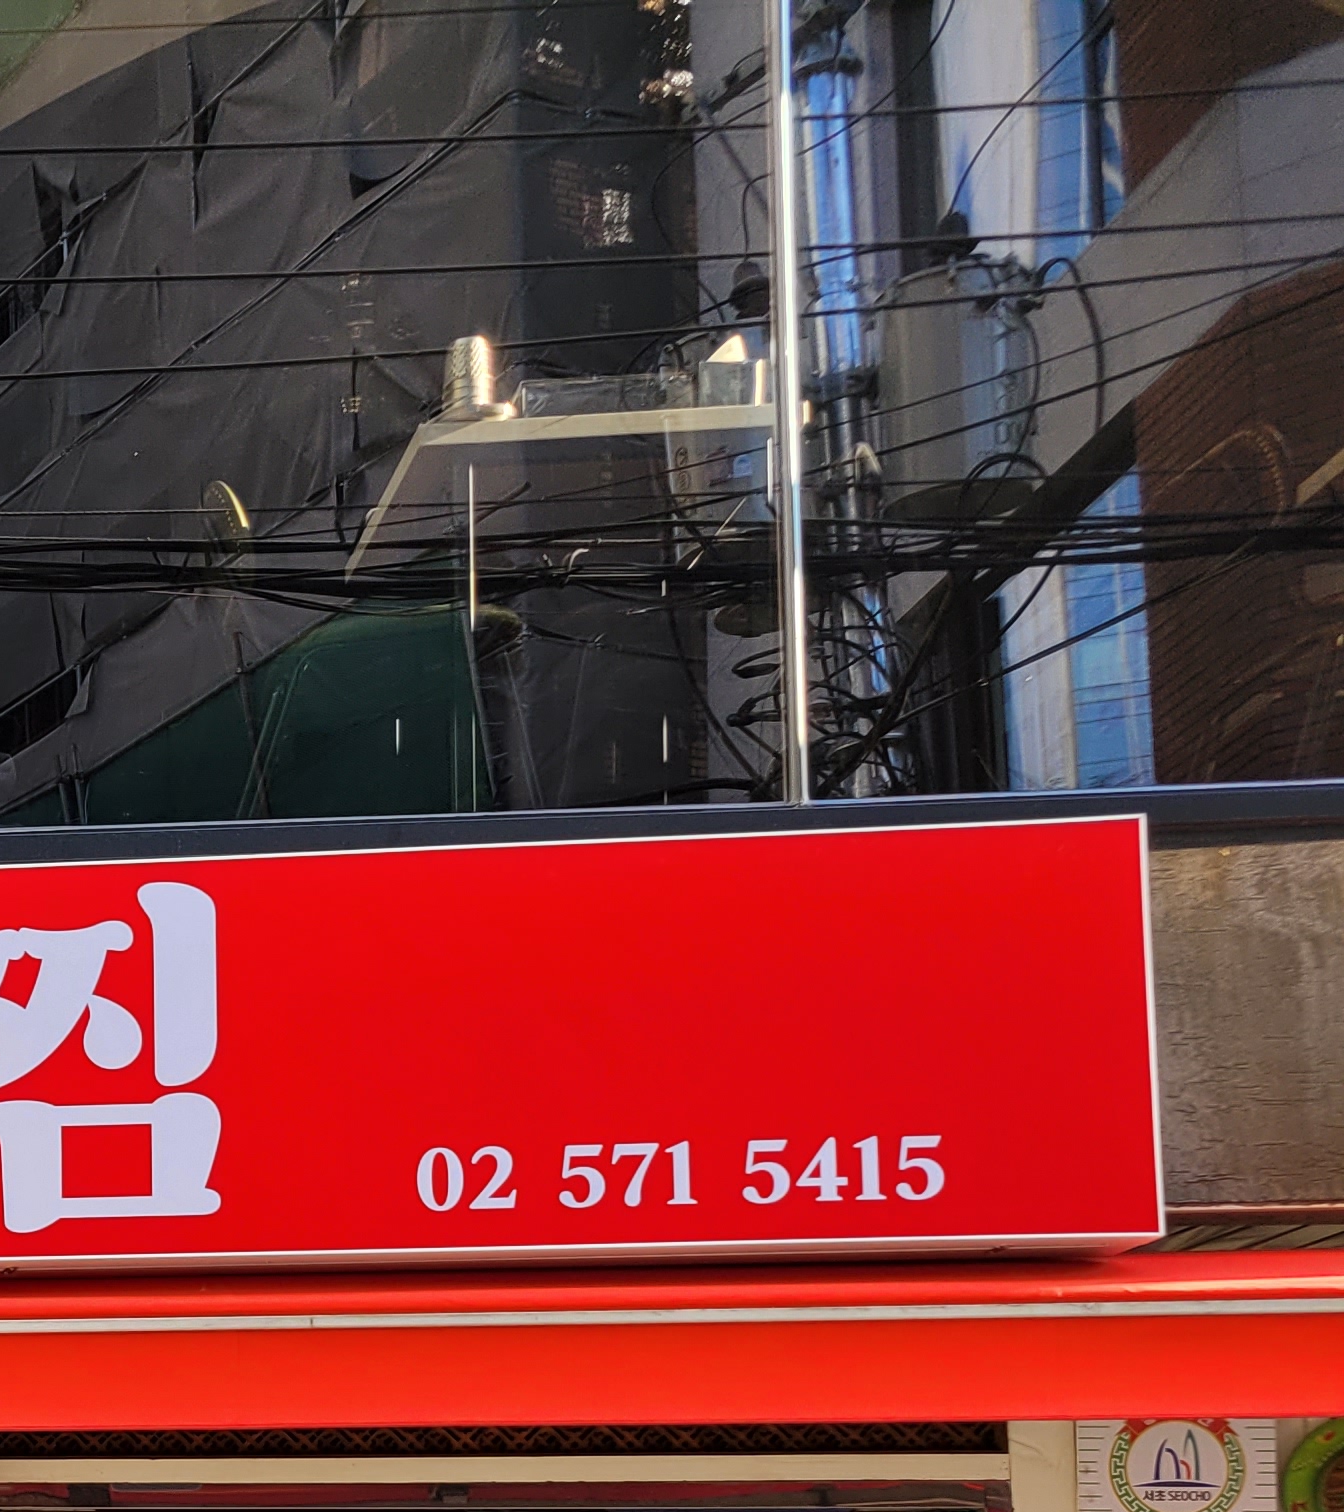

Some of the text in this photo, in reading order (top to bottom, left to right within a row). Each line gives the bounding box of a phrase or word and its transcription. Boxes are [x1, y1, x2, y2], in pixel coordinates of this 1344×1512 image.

[417, 1135, 945, 1211] 02 571 5415
[1167, 1490, 1211, 1501] SEOCHO
